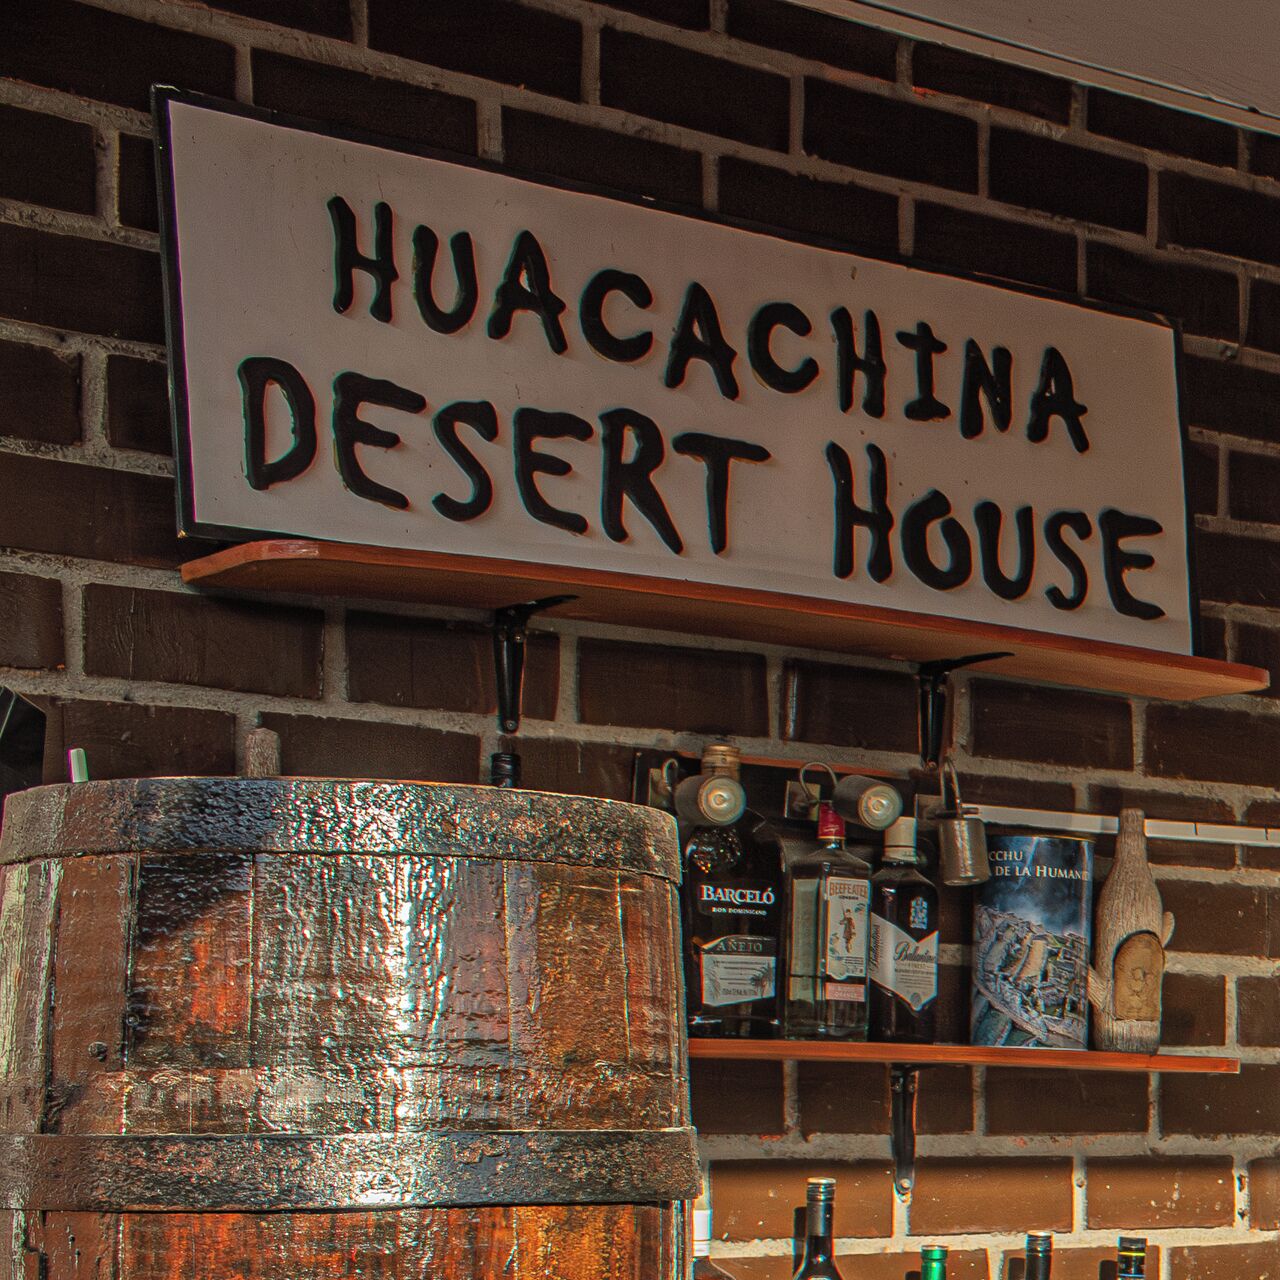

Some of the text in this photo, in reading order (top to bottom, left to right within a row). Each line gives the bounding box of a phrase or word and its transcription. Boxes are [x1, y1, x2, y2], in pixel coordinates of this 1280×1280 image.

[327, 195, 1090, 454] HUACACHINA
[237, 355, 1167, 621] DESERT HOUSE
[988, 850, 1023, 862] CCHU
[995, 865, 1011, 877] DE
[1015, 865, 1032, 877] LA
[701, 884, 776, 906] BARCELÓ
[716, 938, 763, 953] AÑEJO
